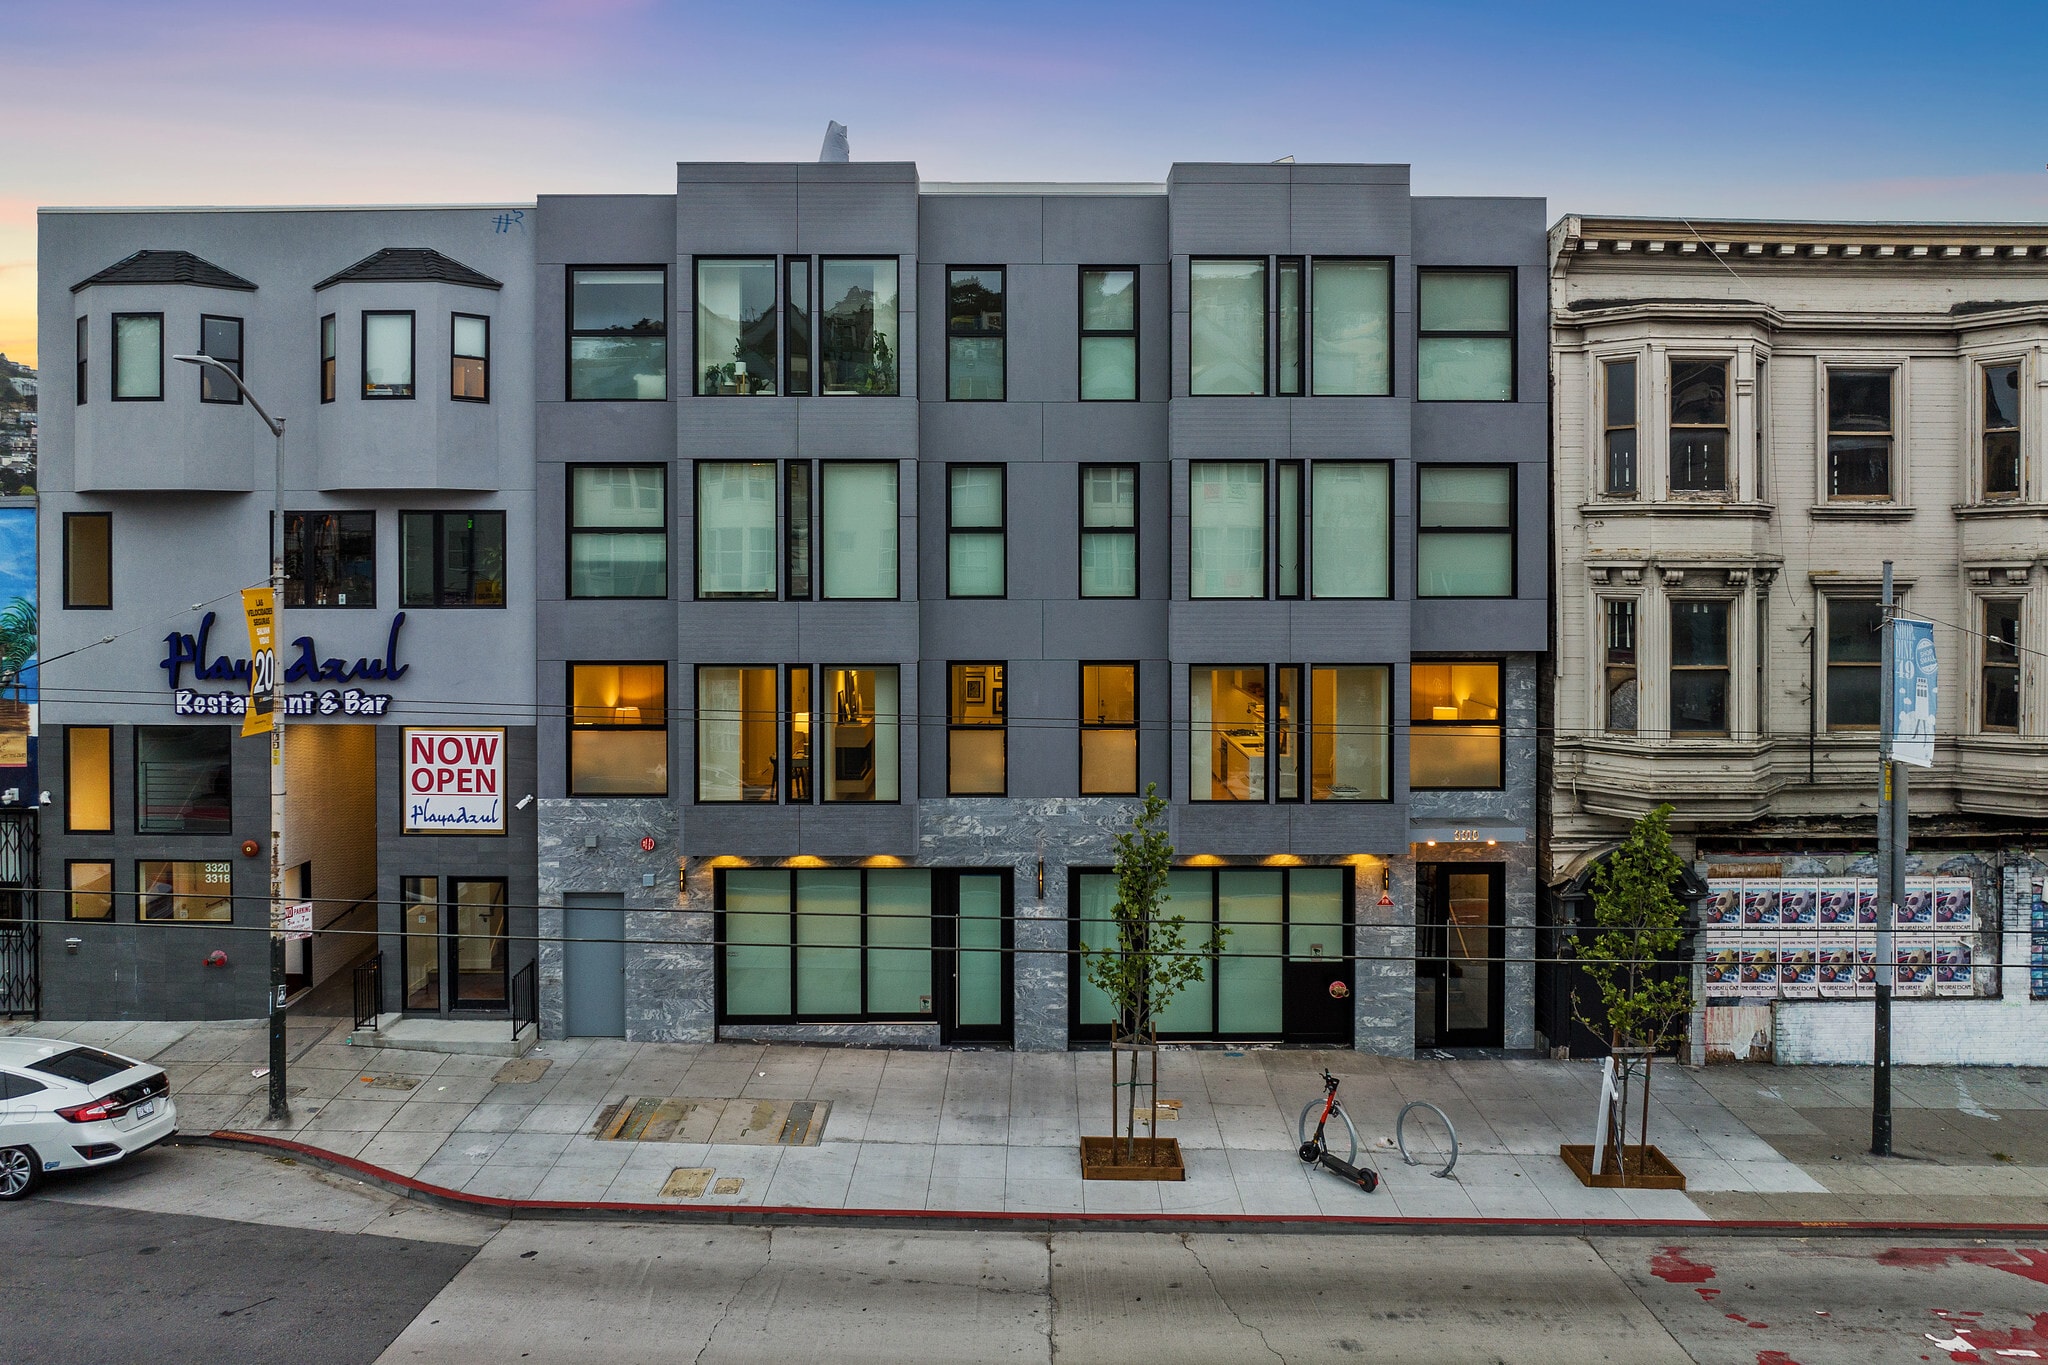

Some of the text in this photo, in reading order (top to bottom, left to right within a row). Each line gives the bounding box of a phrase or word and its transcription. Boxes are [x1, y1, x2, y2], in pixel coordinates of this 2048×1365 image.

[1920, 649, 1934, 658] SHOP
[1920, 655, 1937, 665] SMALL
[253, 649, 274, 694] 20
[1895, 660, 1915, 679] 49
[175, 688, 389, 715] Restant & Bar
[411, 736, 499, 765] NOW
[411, 767, 496, 793] OPEN
[1453, 829, 1479, 841] 3310
[205, 863, 231, 873] 3320
[205, 873, 231, 883] 3318
